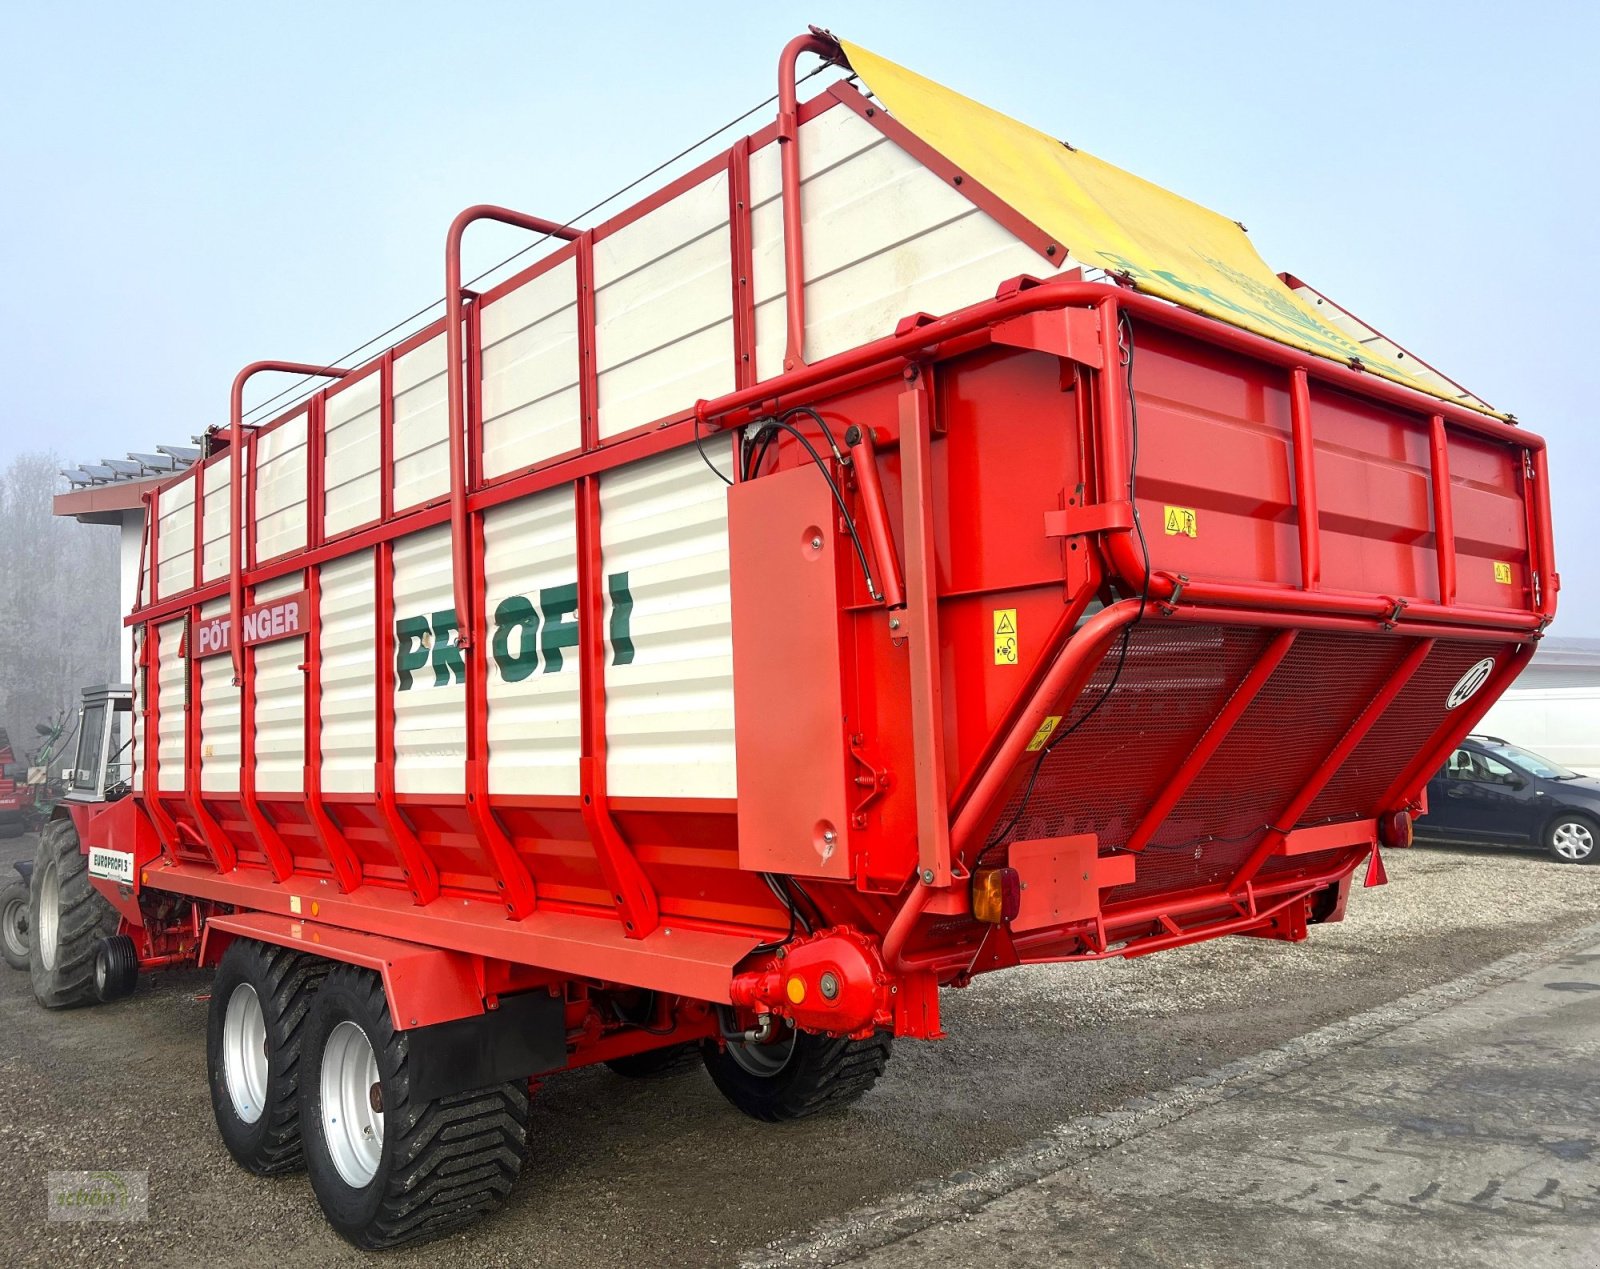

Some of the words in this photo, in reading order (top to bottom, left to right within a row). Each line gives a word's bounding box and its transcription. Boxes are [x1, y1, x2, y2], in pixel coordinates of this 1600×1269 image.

[199, 601, 299, 654] PÖTNGER
[396, 571, 635, 692] PROFI
[1453, 668, 1489, 701] 40
[94, 854, 123, 872] EUROPROFI
